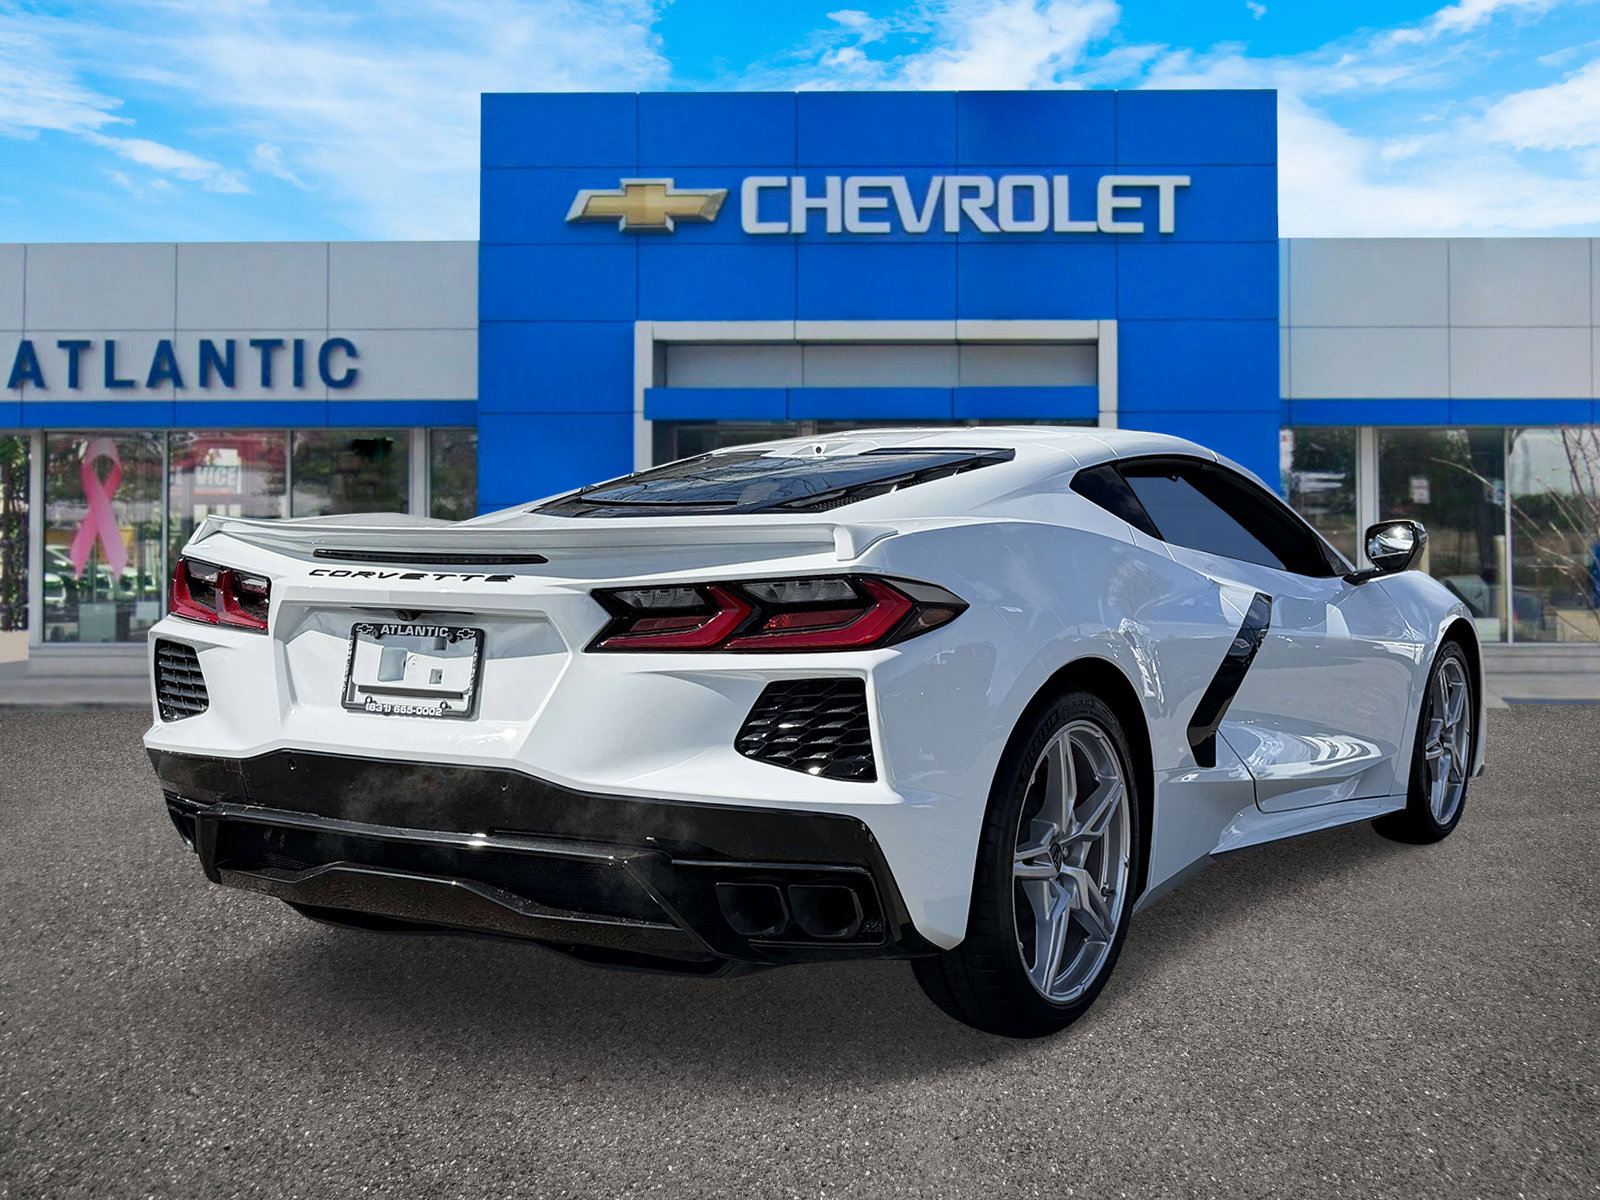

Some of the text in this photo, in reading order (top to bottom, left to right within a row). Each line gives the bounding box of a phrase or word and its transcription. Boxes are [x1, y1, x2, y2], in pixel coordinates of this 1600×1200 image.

[741, 175, 1191, 235] CHEVROLET
[7, 338, 361, 389] ATLANTIC
[309, 569, 516, 583] CORVETTE
[380, 624, 449, 637] ATLANTIC
[365, 702, 443, 717] (631) 665-0002
